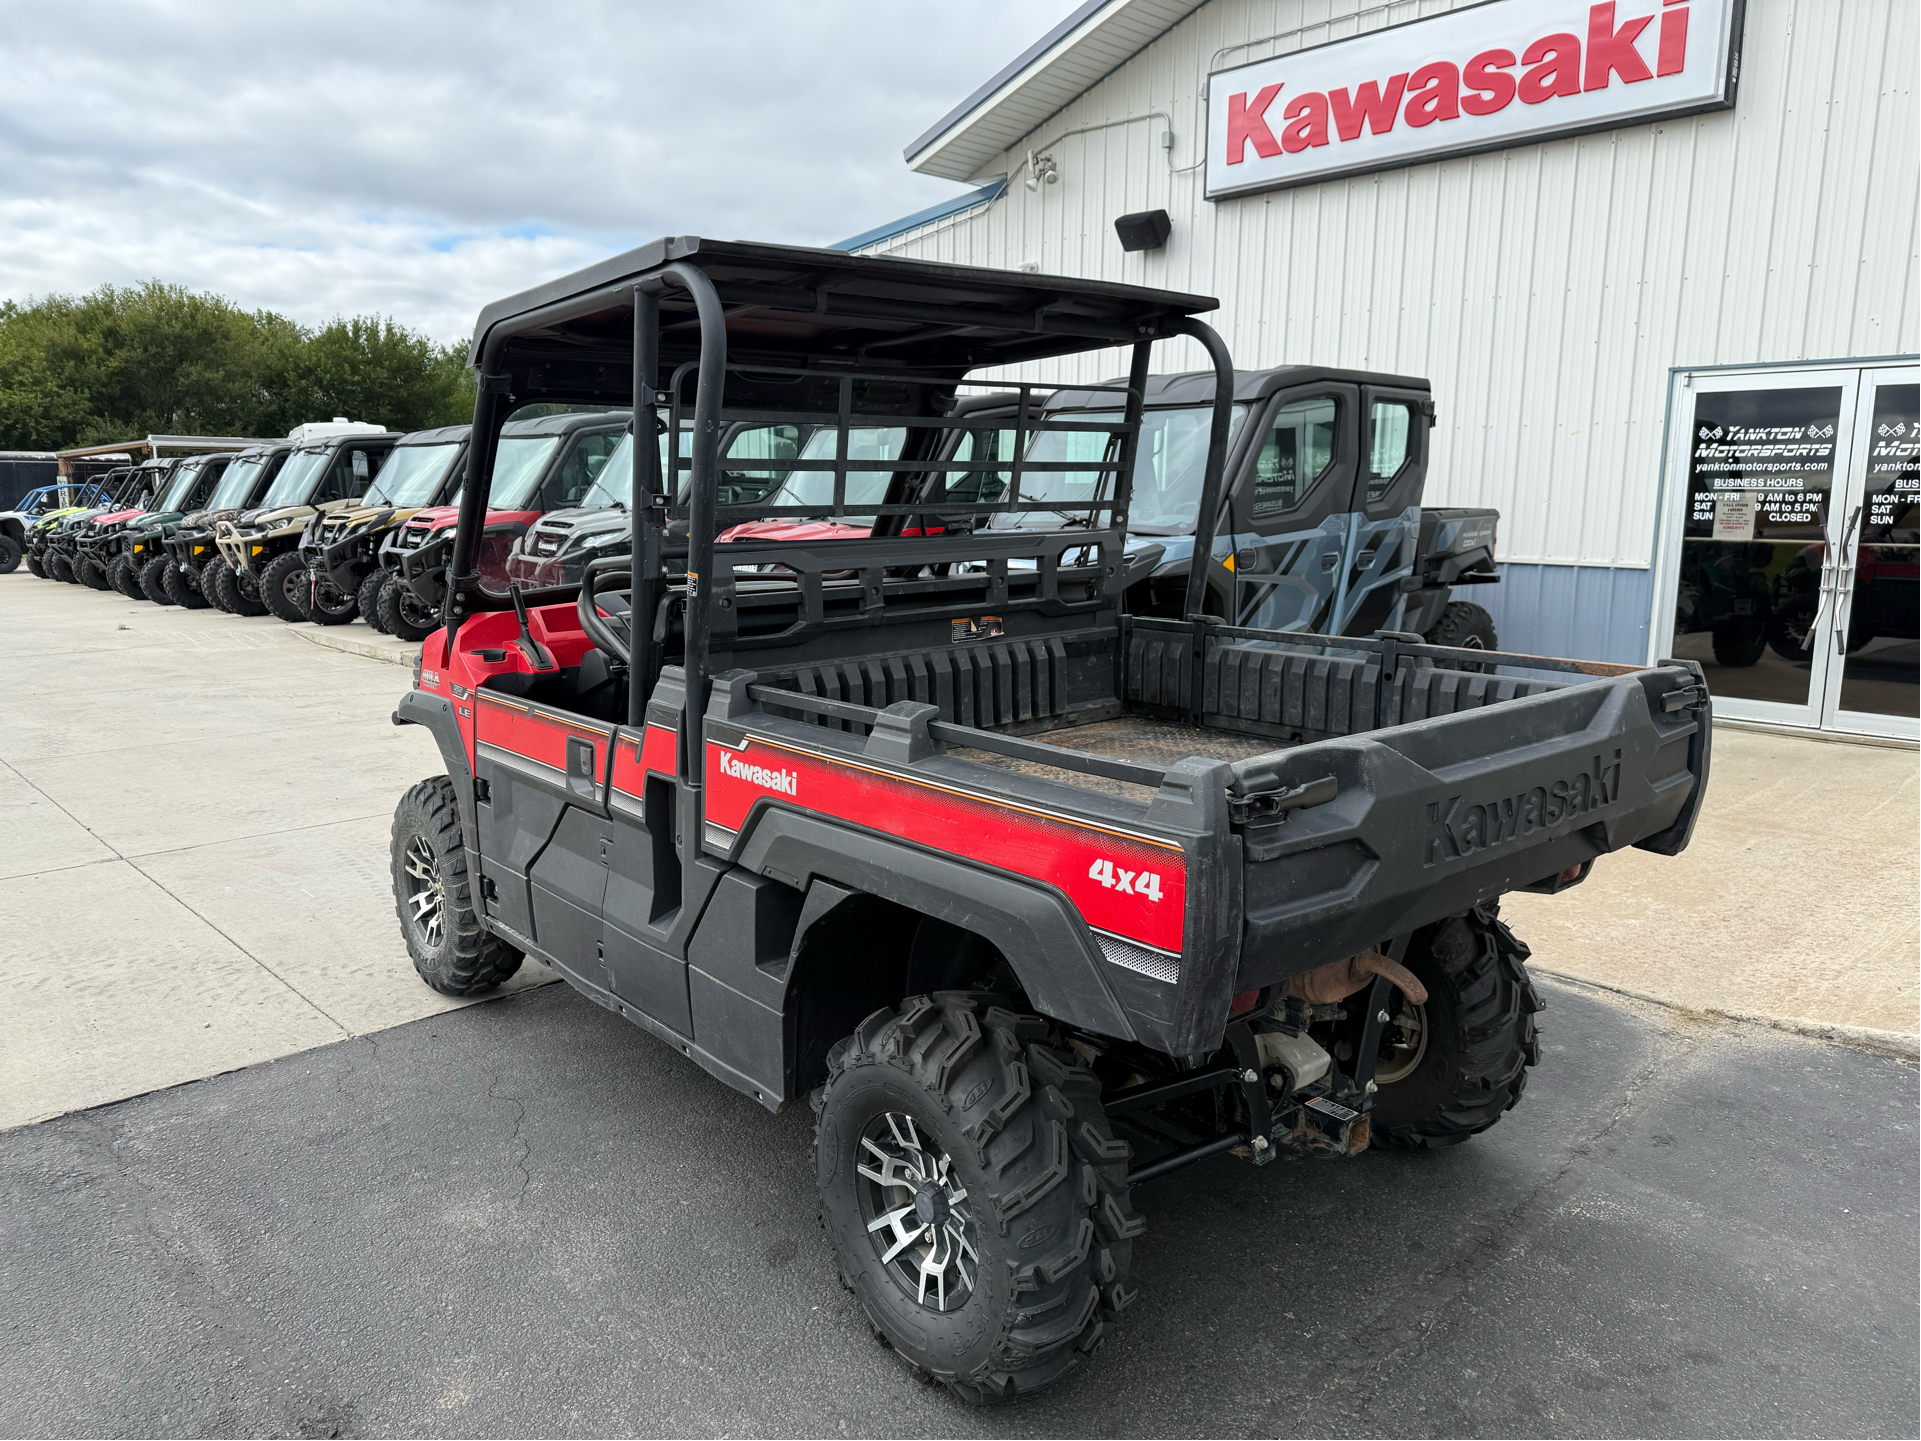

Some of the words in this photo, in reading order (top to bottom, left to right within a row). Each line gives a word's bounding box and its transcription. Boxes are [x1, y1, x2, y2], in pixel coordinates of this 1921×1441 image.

[1226, 0, 1690, 166] Kawasaki
[1726, 425, 1805, 441] YANKTON
[1694, 443, 1833, 457] MOTORSPORTS
[1695, 461, 1828, 473] yanktonmotorsports.com
[1713, 478, 1765, 487] BUSINESS
[1766, 478, 1804, 487] HOURS
[1895, 479, 1921, 489] BUS
[1694, 492, 1718, 501] MON
[1724, 492, 1740, 501] FRI
[1757, 493, 1764, 502] 9
[1765, 493, 1783, 502] AM
[1785, 493, 1795, 502] to
[1797, 493, 1804, 502] 6
[1806, 493, 1822, 502] PM
[1872, 494, 1899, 503] MON
[1693, 502, 1713, 510] SAT
[1754, 503, 1761, 512] 9
[1763, 503, 1780, 511] AM
[1781, 503, 1791, 511] to
[1793, 503, 1801, 511] 5
[1802, 503, 1818, 511] PM
[1871, 504, 1893, 514] SAT
[1692, 511, 1714, 520] SUN
[1768, 513, 1811, 522] CLOSED
[1870, 515, 1894, 524] SUN
[458, 706, 471, 719] LE
[720, 750, 798, 796] Kawasaki
[1423, 748, 1622, 869] Kawasaki
[1088, 857, 1164, 903] 4x4
